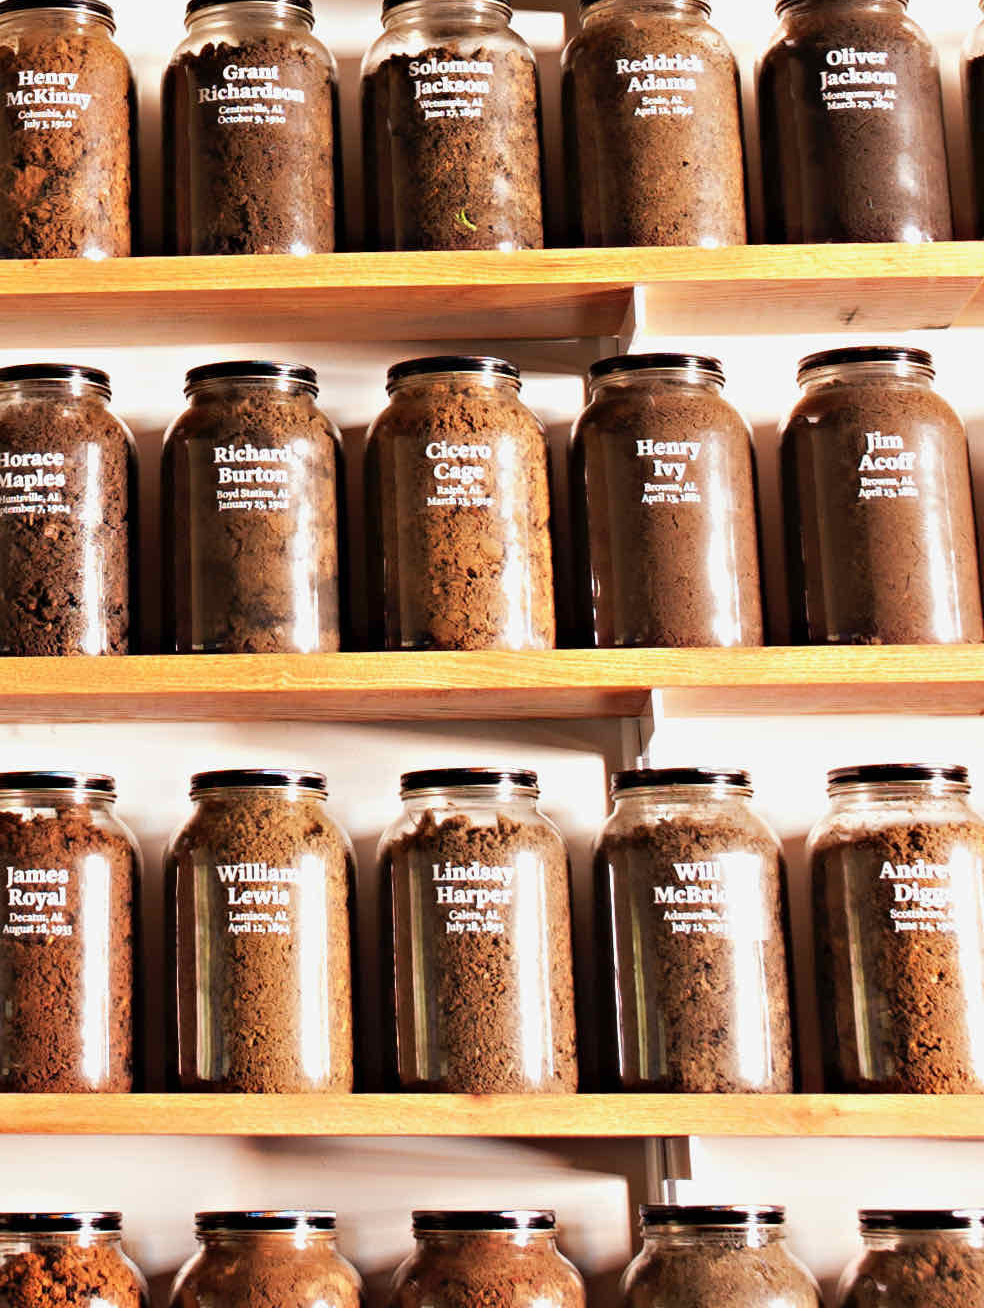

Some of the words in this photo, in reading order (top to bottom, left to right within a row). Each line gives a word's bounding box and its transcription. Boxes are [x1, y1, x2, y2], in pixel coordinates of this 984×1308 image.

[615, 54, 704, 74] Reddrick
[825, 47, 888, 66] Oliver
[222, 64, 279, 81] Grant
[408, 58, 494, 77] Solomon
[17, 71, 78, 90] Henry
[414, 77, 489, 99] Jackson
[627, 74, 696, 93] Adams
[820, 67, 897, 90] Jackson
[5, 88, 91, 110] McKinny
[197, 83, 305, 103] Richardson
[425, 441, 492, 460] Cicero
[635, 439, 701, 460] Henry
[864, 431, 904, 453] Jim
[213, 444, 292, 464] Richard
[858, 451, 916, 471] Acoff
[218, 466, 288, 484] Burton
[433, 462, 485, 484] Cage
[651, 459, 686, 480] Ivy
[6, 867, 69, 888] James
[8, 887, 66, 910] Royal
[227, 885, 290, 905] Lewis
[436, 885, 513, 908] Harper
[3, 924, 34, 935] August
